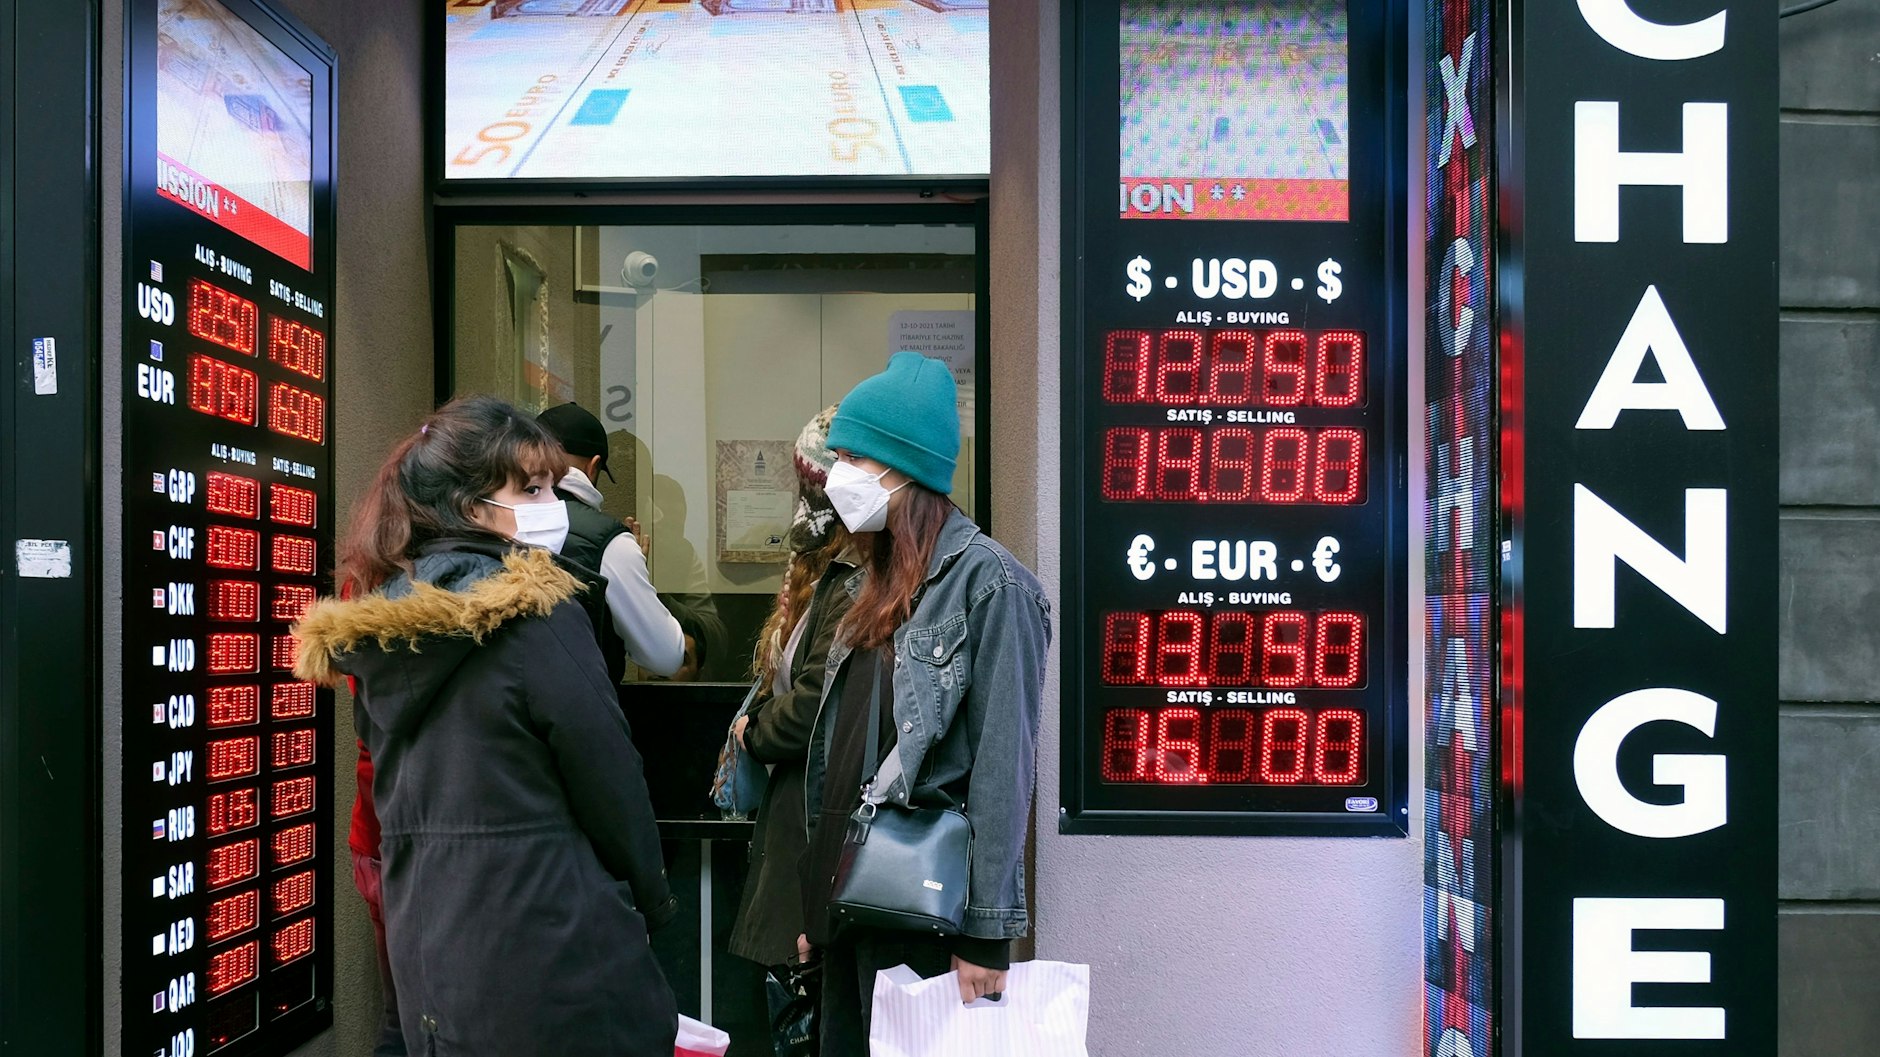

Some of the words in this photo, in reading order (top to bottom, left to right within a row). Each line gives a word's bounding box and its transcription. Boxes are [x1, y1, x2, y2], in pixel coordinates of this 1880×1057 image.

[451, 120, 532, 165] 50
[220, 255, 252, 285] BUYING
[1193, 258, 1277, 299] USD
[138, 280, 174, 325] USD
[295, 291, 324, 318] SELLING
[1176, 311, 1212, 326] ALIŞ
[1227, 312, 1289, 324] BUYING
[138, 363, 174, 405] EUR
[1167, 409, 1212, 424] SATIŞ
[1227, 410, 1295, 423] SELLING
[231, 447, 256, 466] BUYING
[292, 461, 316, 480] SELLING
[169, 469, 195, 504] GBP
[169, 525, 194, 559] CHF
[1436, 30, 1478, 1057] XCHAN
[1192, 540, 1277, 580] EUR
[169, 582, 194, 615] DKK
[1178, 592, 1214, 607] ALIŞ
[1229, 593, 1291, 604] BUYING
[169, 639, 194, 672] AUD
[169, 695, 194, 729] CAD
[1167, 691, 1212, 706] SATIŞ
[1227, 692, 1295, 704] SELLING
[169, 751, 192, 786] JPY
[169, 806, 194, 842] RUB
[169, 862, 193, 899] SAR
[169, 917, 194, 956] AED
[169, 972, 194, 1012] QAR
